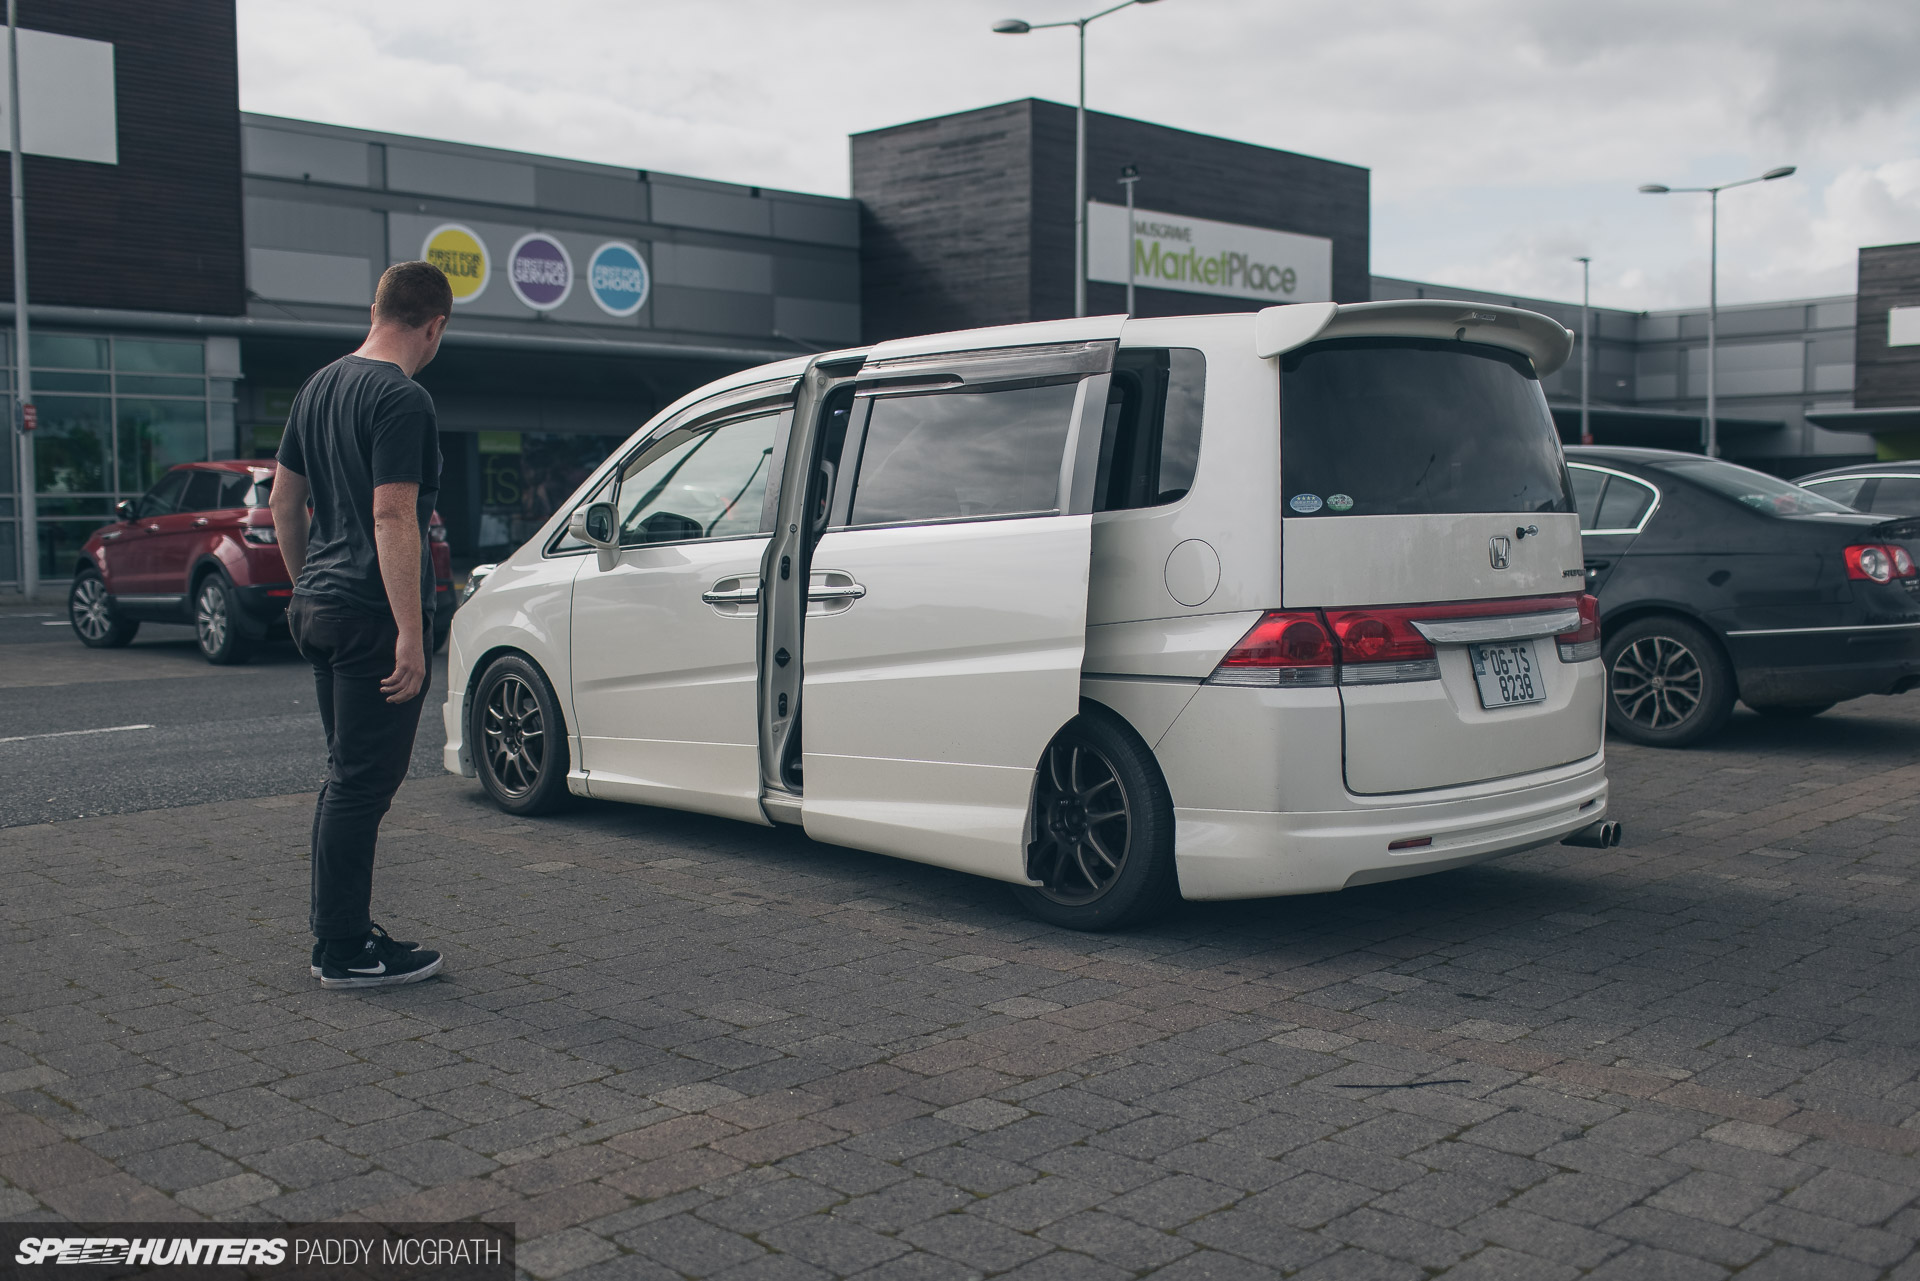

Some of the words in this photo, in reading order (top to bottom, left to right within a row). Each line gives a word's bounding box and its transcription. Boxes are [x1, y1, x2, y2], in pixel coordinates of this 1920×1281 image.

[428, 248, 459, 265] FIRST
[459, 252, 482, 265] FOR
[515, 257, 545, 272] FIRST
[595, 265, 622, 280] FIRST
[1134, 238, 1297, 295] MarketPlace
[513, 270, 568, 287] SERVICE
[593, 278, 643, 294] CHOICE
[1490, 647, 1531, 676] 06-TS
[1499, 673, 1534, 702] 8238
